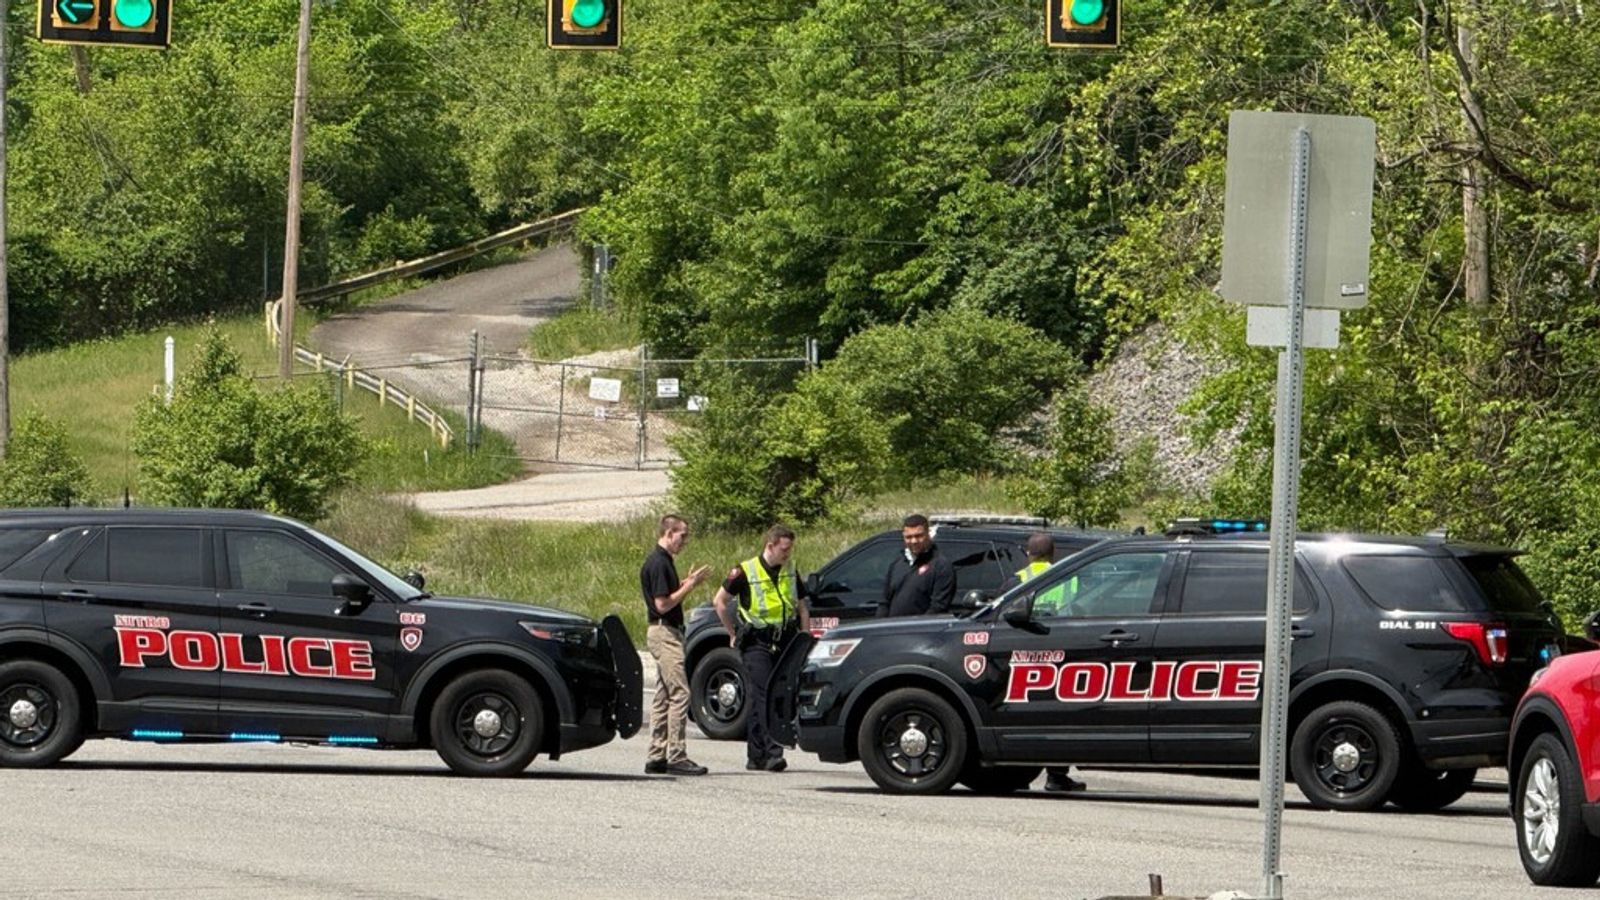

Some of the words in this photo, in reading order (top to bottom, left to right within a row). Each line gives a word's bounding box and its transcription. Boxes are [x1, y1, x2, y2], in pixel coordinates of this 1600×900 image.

[114, 614, 170, 629] NITRO
[400, 612, 426, 625] 06
[1379, 621, 1412, 629] DIAL
[1415, 621, 1436, 629] 911
[963, 631, 989, 645] 09
[114, 626, 376, 680] POLICE
[1010, 650, 1065, 662] NITRO
[1004, 660, 1262, 702] POLICE
